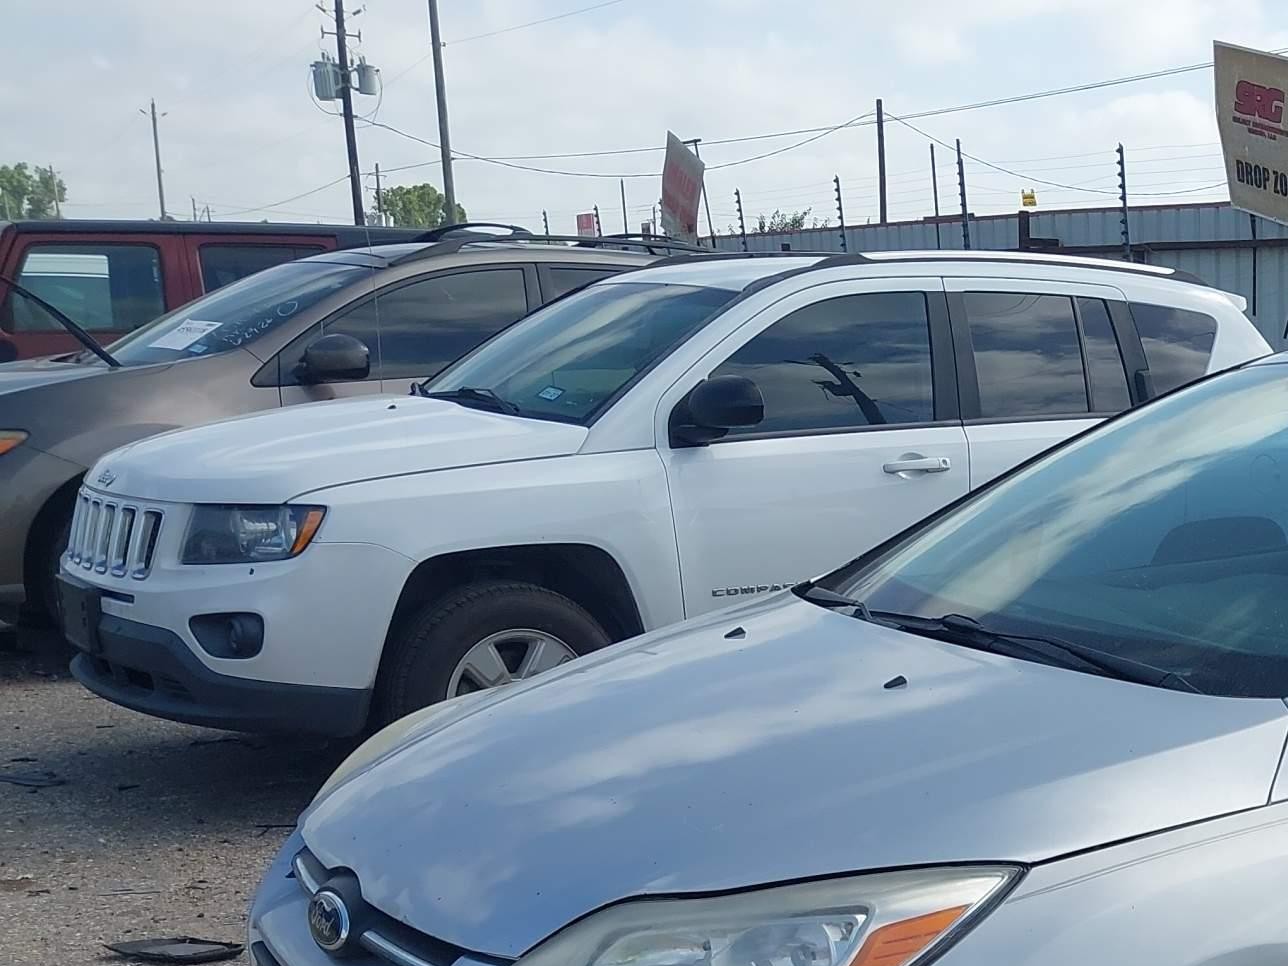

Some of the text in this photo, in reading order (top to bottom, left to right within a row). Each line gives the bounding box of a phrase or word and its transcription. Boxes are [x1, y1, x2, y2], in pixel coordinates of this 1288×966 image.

[1235, 80, 1285, 123] SRG
[1236, 159, 1270, 190] DROP
[311, 899, 335, 937] Ford
